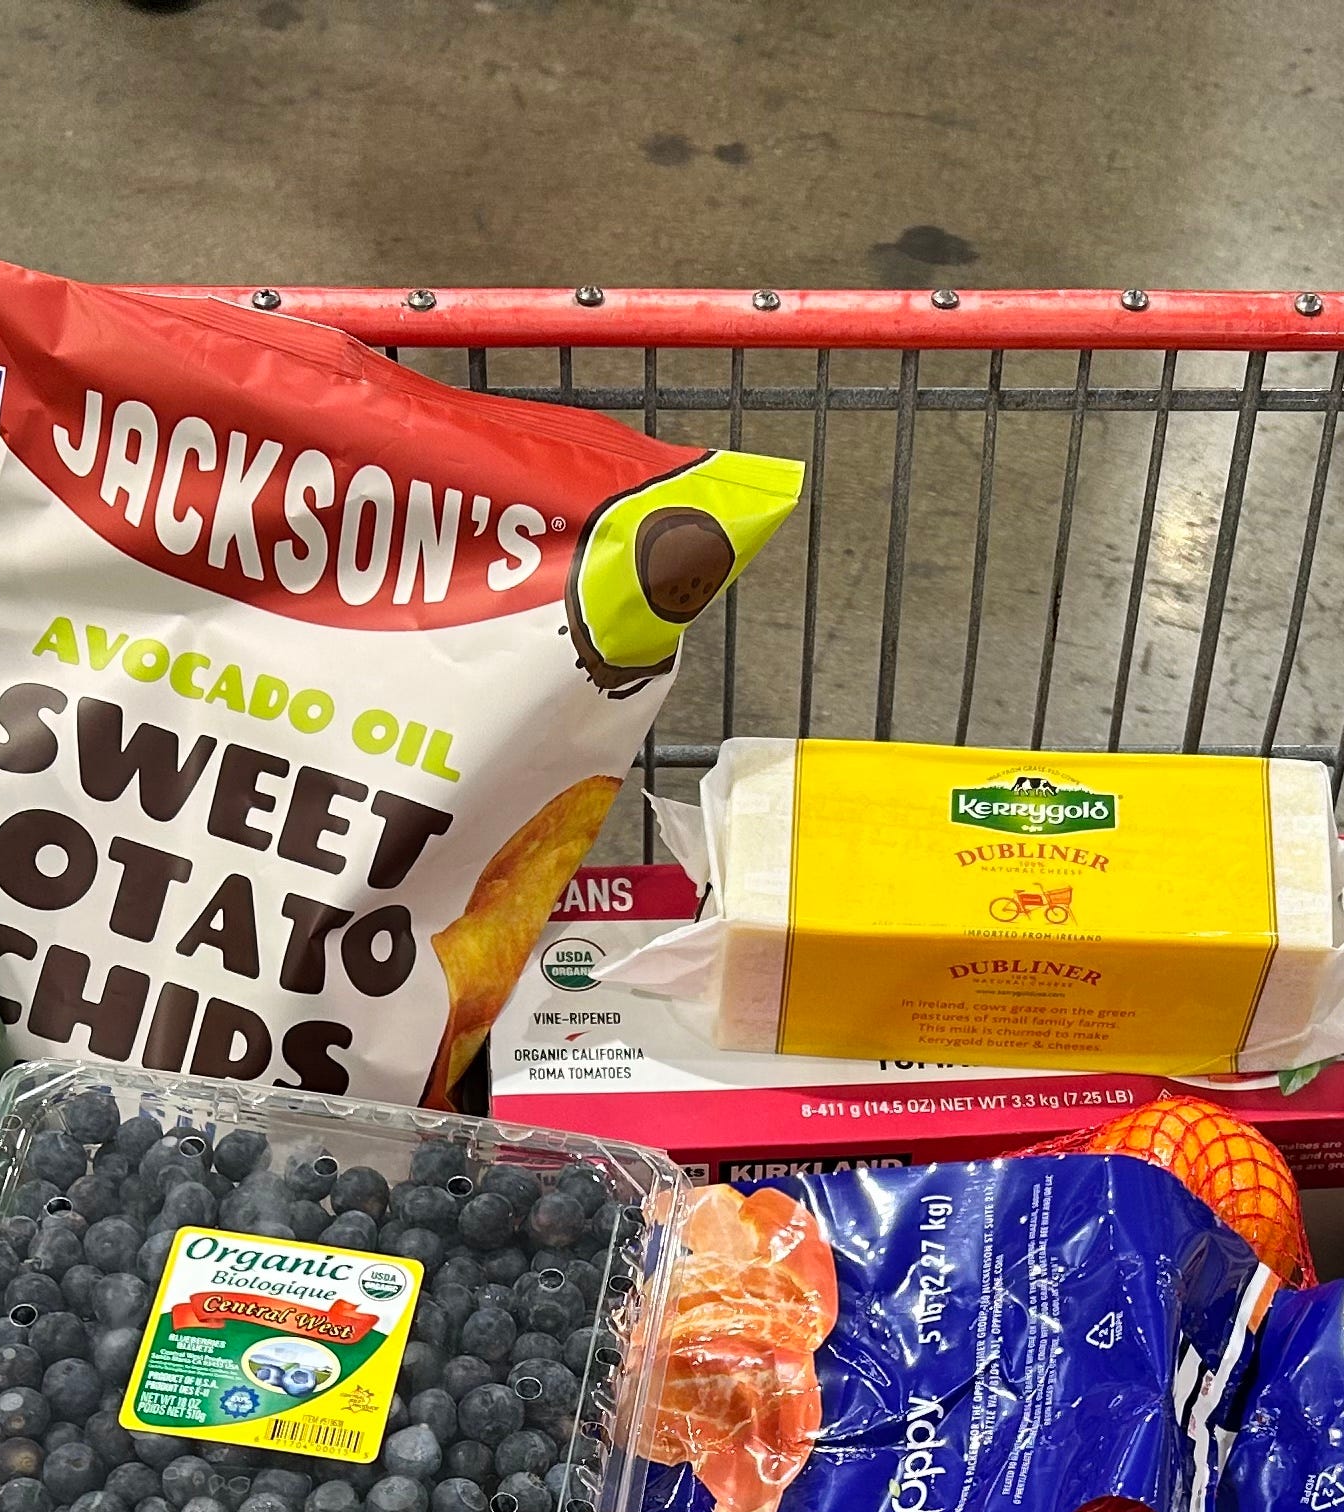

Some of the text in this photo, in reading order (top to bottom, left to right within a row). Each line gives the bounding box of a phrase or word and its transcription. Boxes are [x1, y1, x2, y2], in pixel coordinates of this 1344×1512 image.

[53, 390, 544, 607] JACKSON'S
[32, 616, 462, 784] AVOCADO OIL
[958, 794, 1109, 825] Kerrygold
[954, 842, 1110, 874] DUBLINER
[556, 951, 593, 963] USDA
[948, 959, 1103, 987] DUBLINER
[534, 1012, 621, 1025] VINE-RIPENED
[514, 1047, 645, 1061] ORGANIC CALIFORNIA
[529, 1066, 632, 1081] ROMA TOMATOES
[801, 1088, 1134, 1119] 8-411 g (14.5 OZ) NET WT 3.3 kg (7.25 LB)
[186, 1237, 354, 1282] Organic
[210, 1270, 338, 1302] Biologique
[370, 1270, 397, 1283] USDA
[203, 1295, 355, 1341] Central West
